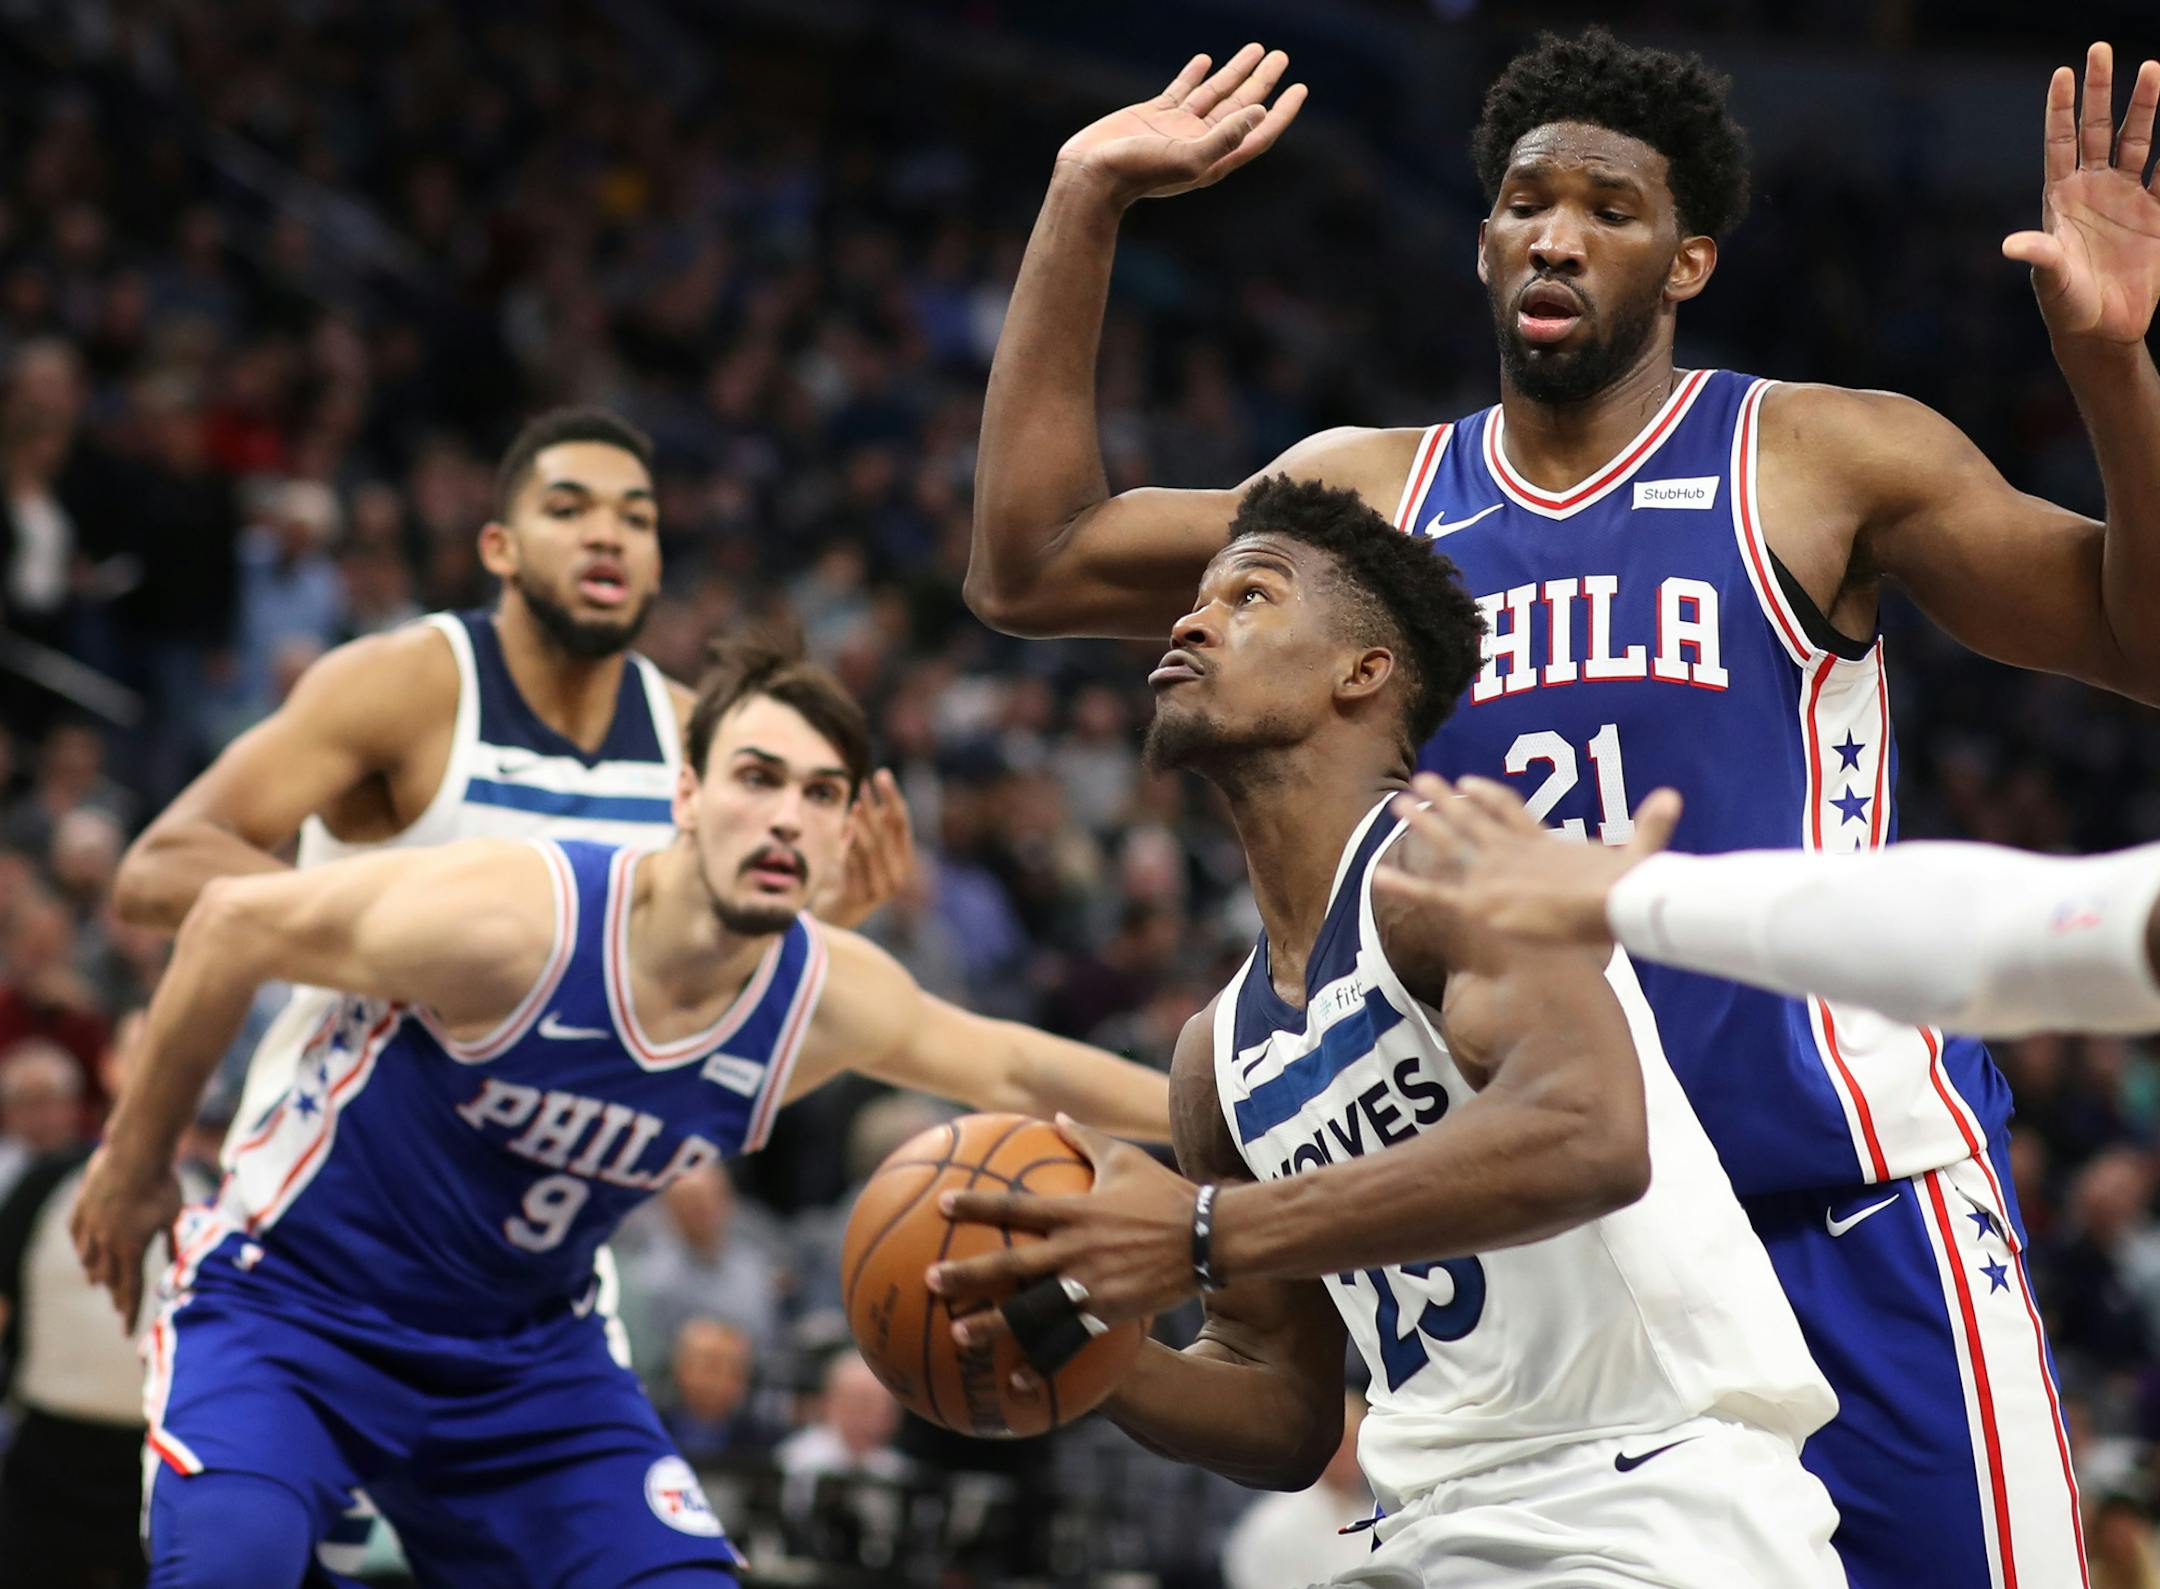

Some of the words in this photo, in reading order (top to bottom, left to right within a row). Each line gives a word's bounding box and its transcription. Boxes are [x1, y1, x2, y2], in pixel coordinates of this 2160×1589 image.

[1643, 487, 1705, 500] StubHub
[1472, 575, 1729, 706] HILA
[1504, 723, 1636, 847] 21
[455, 1078, 720, 1190] PHILA
[502, 1174, 590, 1254] 9
